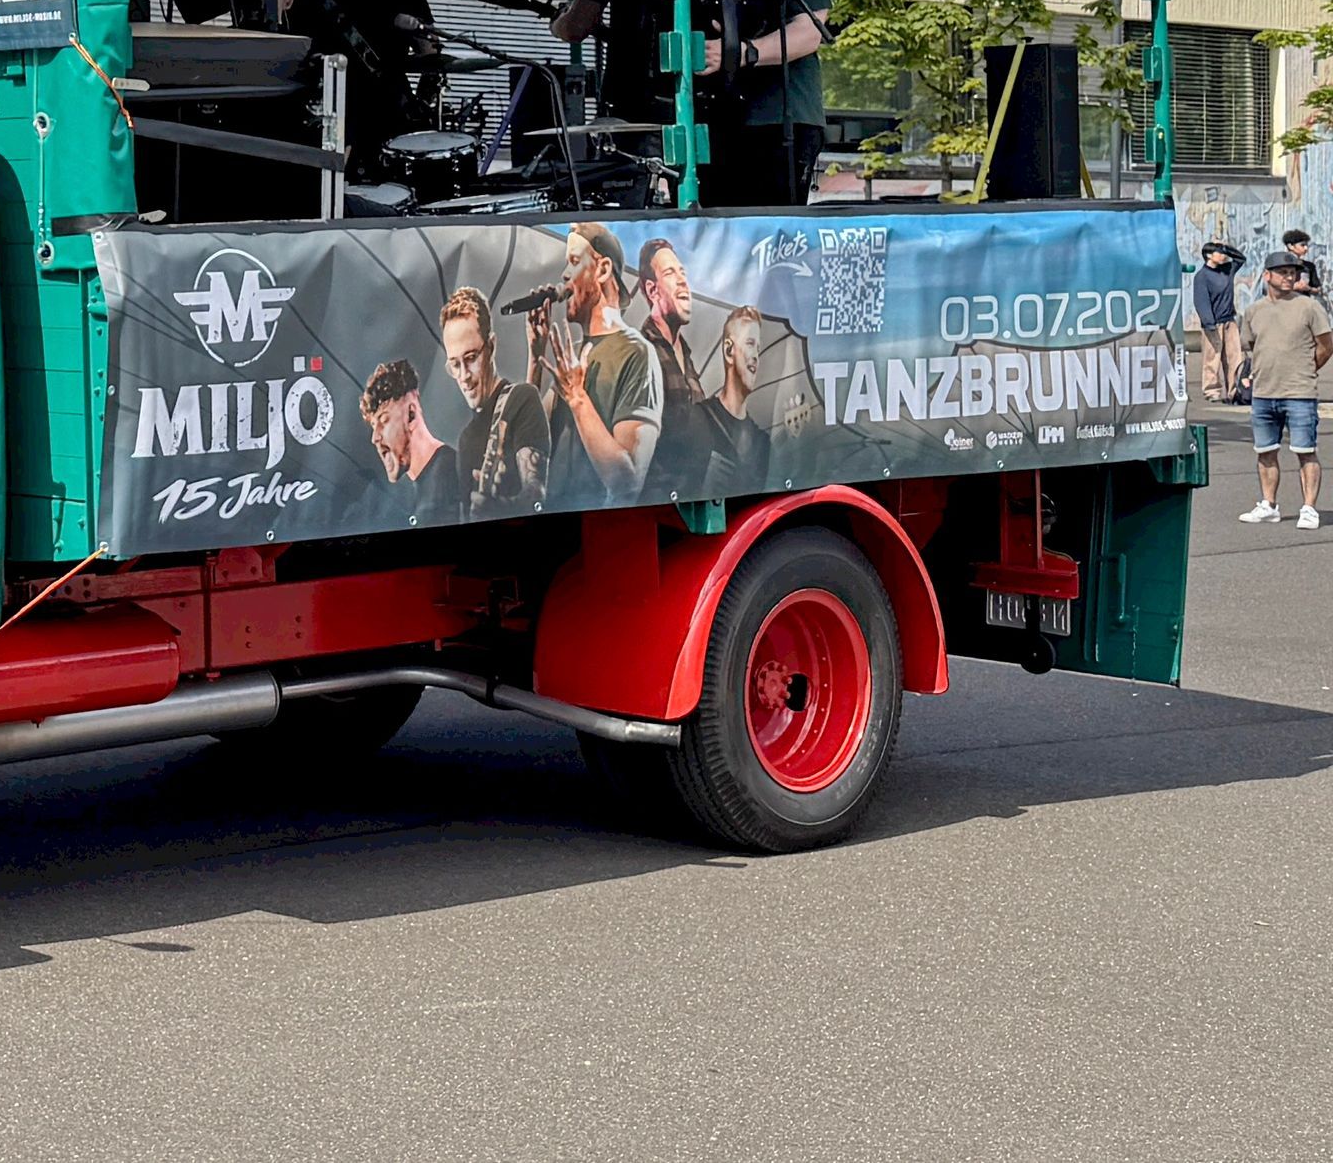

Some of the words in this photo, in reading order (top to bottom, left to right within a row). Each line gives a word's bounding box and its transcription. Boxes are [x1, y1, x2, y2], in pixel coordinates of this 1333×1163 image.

[751, 230, 808, 275] Tickets
[940, 288, 1181, 343] 03.07.2027
[131, 356, 334, 469] MILJÖ
[814, 345, 1188, 426] TANZBRUNNEN
[152, 477, 219, 525] 15
[218, 470, 318, 519] Jahre
